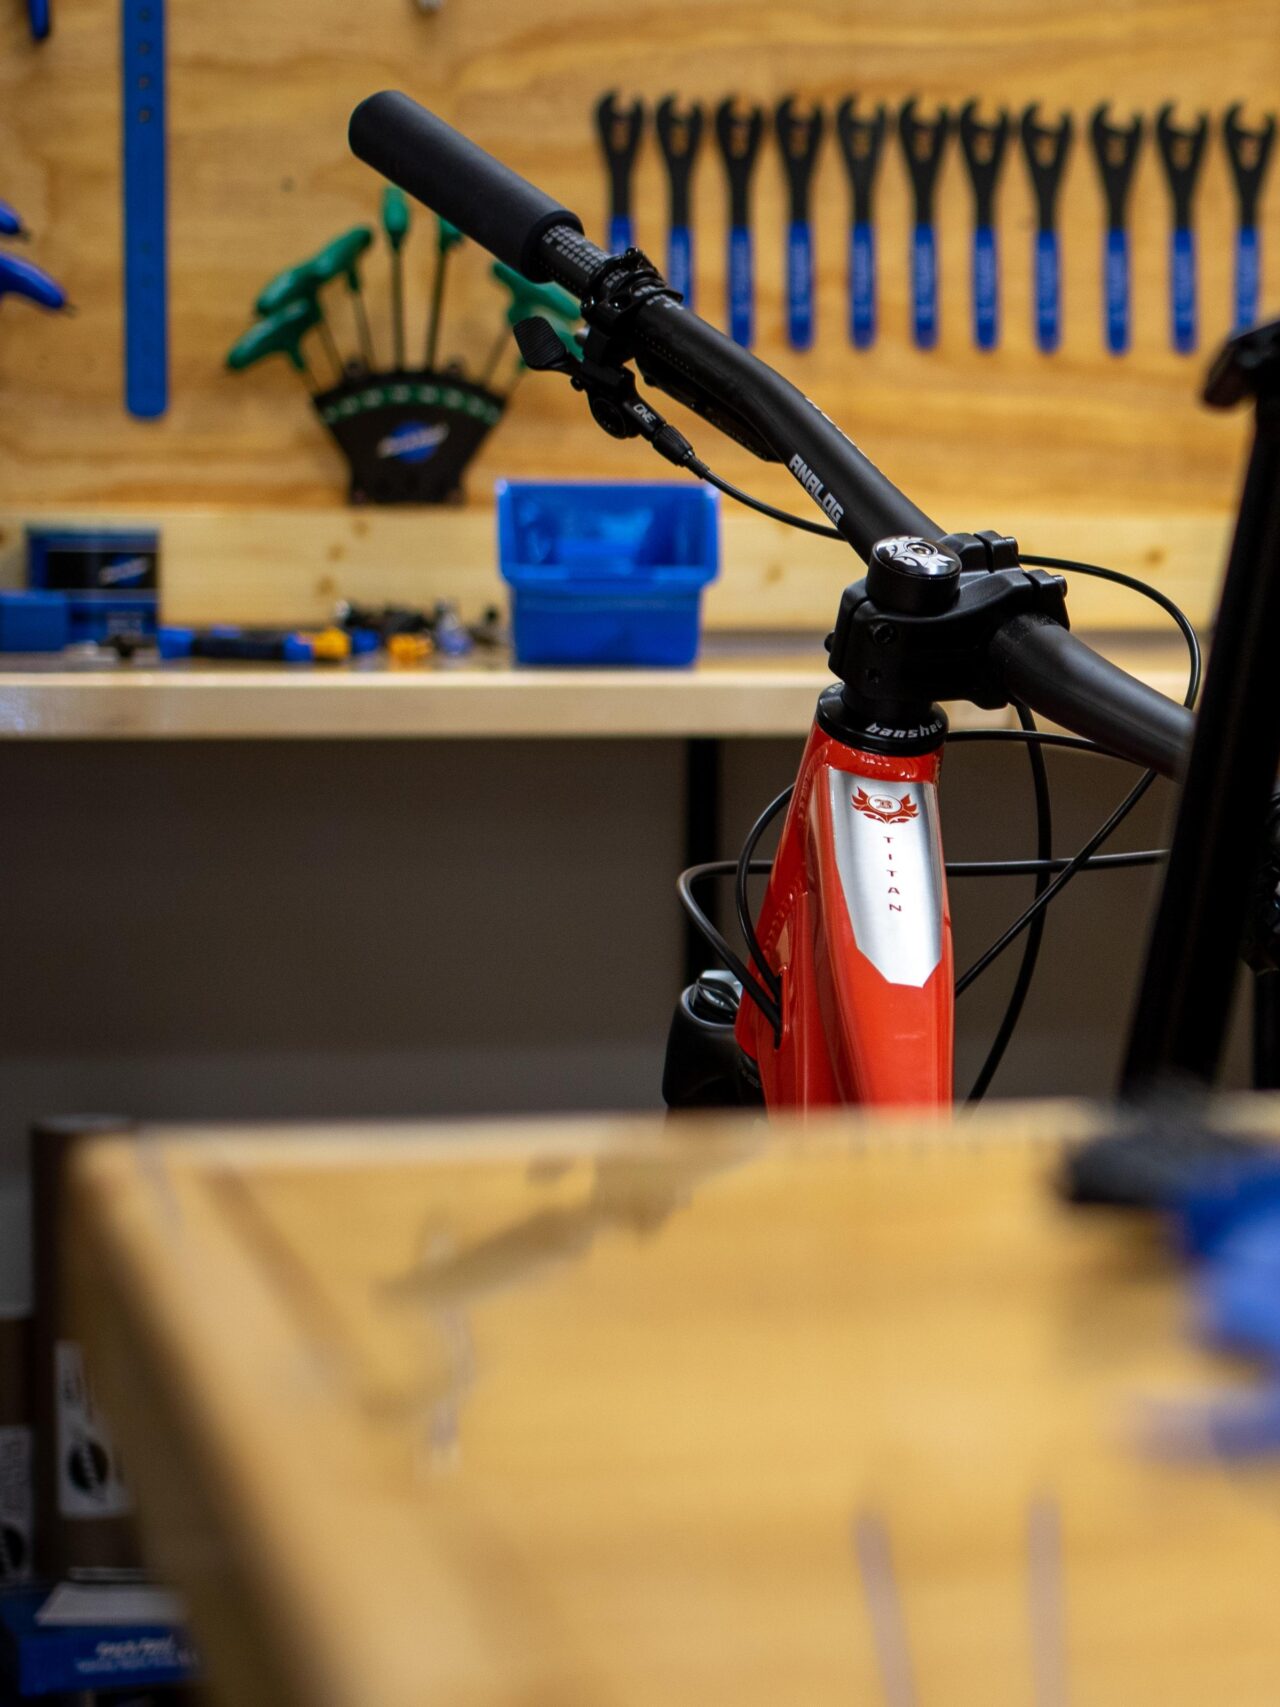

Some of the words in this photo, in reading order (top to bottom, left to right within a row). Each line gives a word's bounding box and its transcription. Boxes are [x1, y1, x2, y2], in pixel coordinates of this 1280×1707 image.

[788, 453, 844, 524] ANALOG
[865, 720, 943, 739] banshee
[883, 835, 903, 912] TITAN
